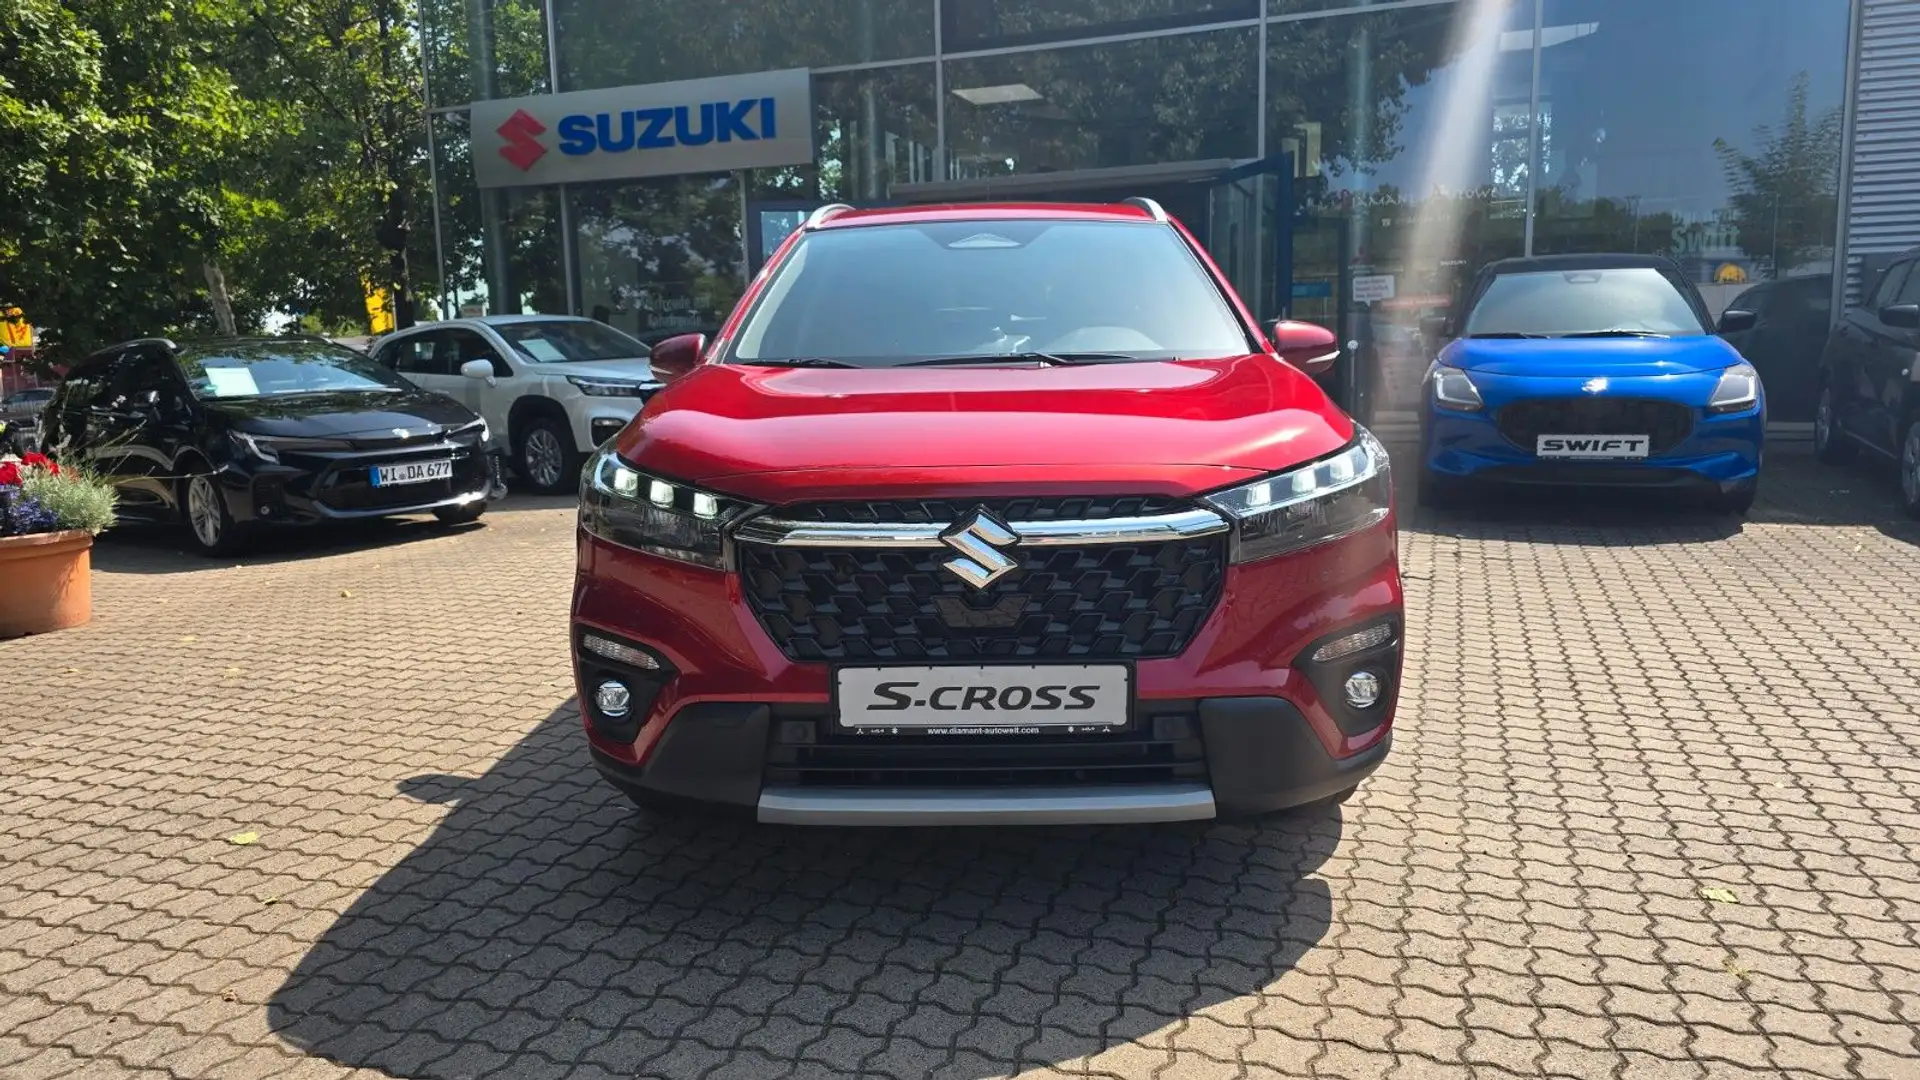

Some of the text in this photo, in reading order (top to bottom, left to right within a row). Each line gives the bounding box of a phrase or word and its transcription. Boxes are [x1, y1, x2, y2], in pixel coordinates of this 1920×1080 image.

[558, 97, 776, 155] SUZUKI
[1542, 439, 1644, 452] SWIFT
[380, 462, 450, 482] WI DA 677
[866, 681, 1101, 711] S-CROSS
[927, 726, 1040, 735] www.diamant-autowelt.com
